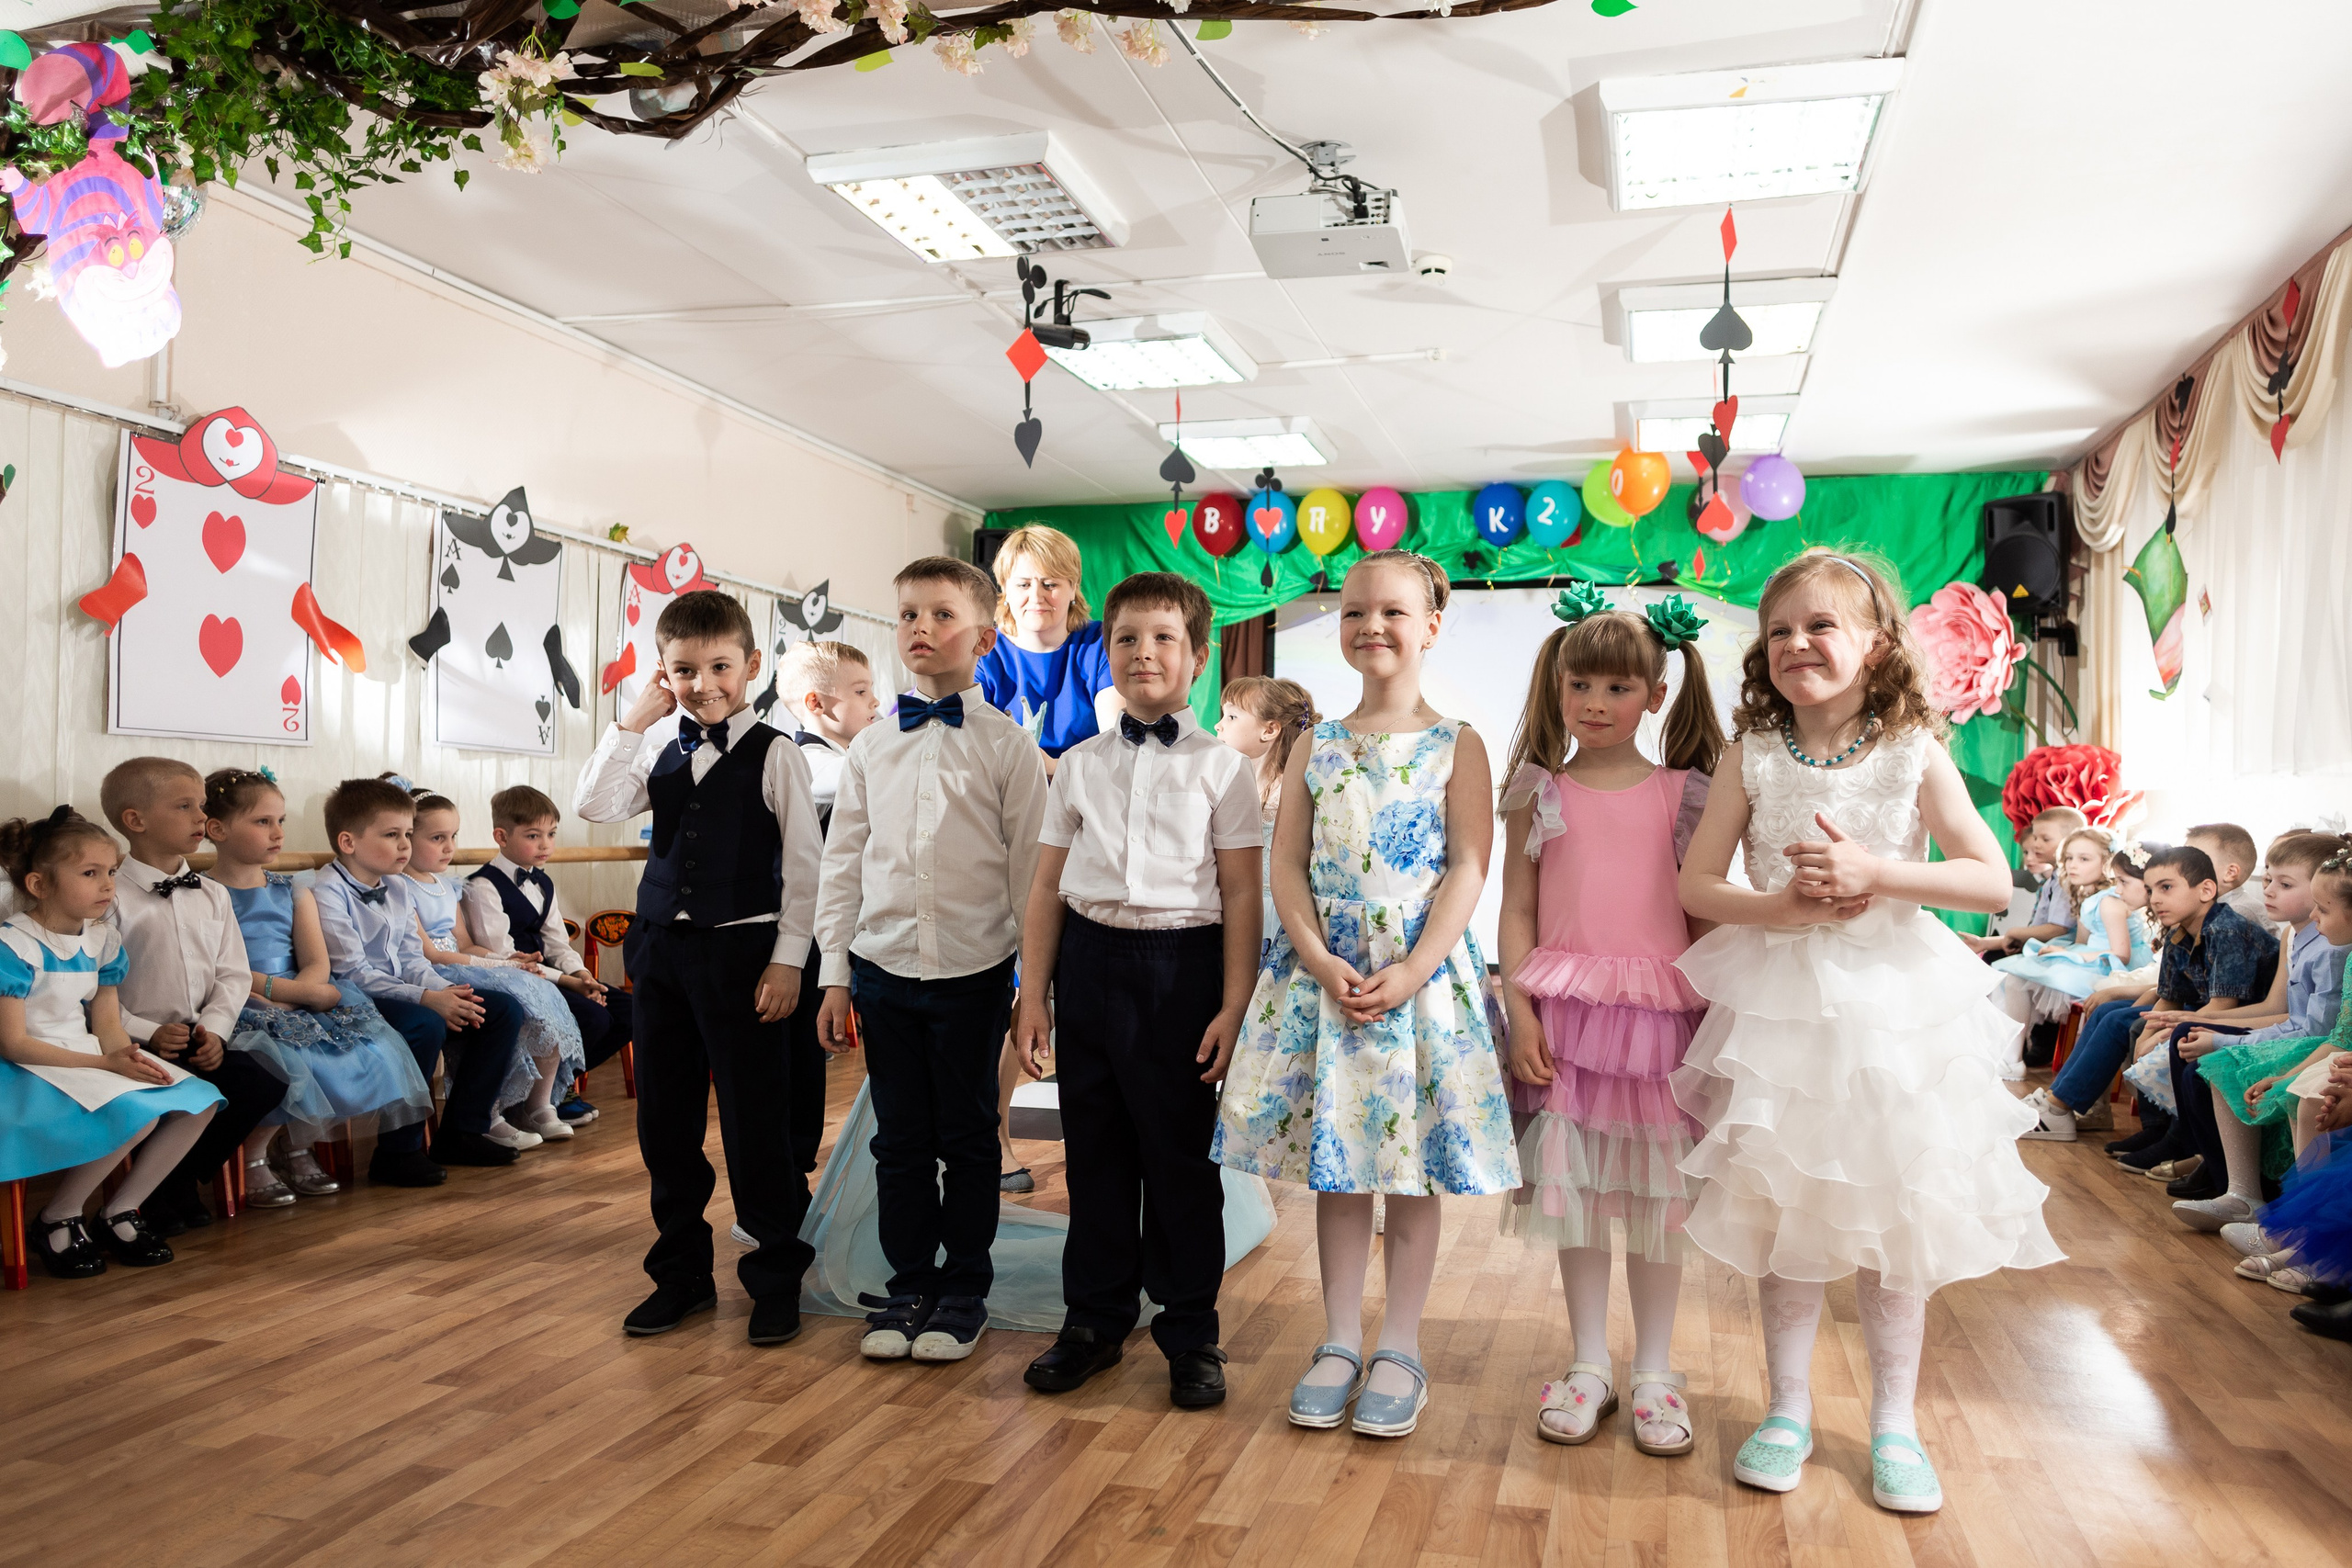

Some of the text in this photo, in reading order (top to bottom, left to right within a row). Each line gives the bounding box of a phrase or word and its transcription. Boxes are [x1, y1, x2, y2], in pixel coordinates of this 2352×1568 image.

[134, 466, 155, 495] 2
[446, 538, 462, 560] A
[627, 584, 641, 604] A
[778, 617, 786, 635] 2
[283, 707, 300, 732] 2
[537, 725, 551, 745] A
